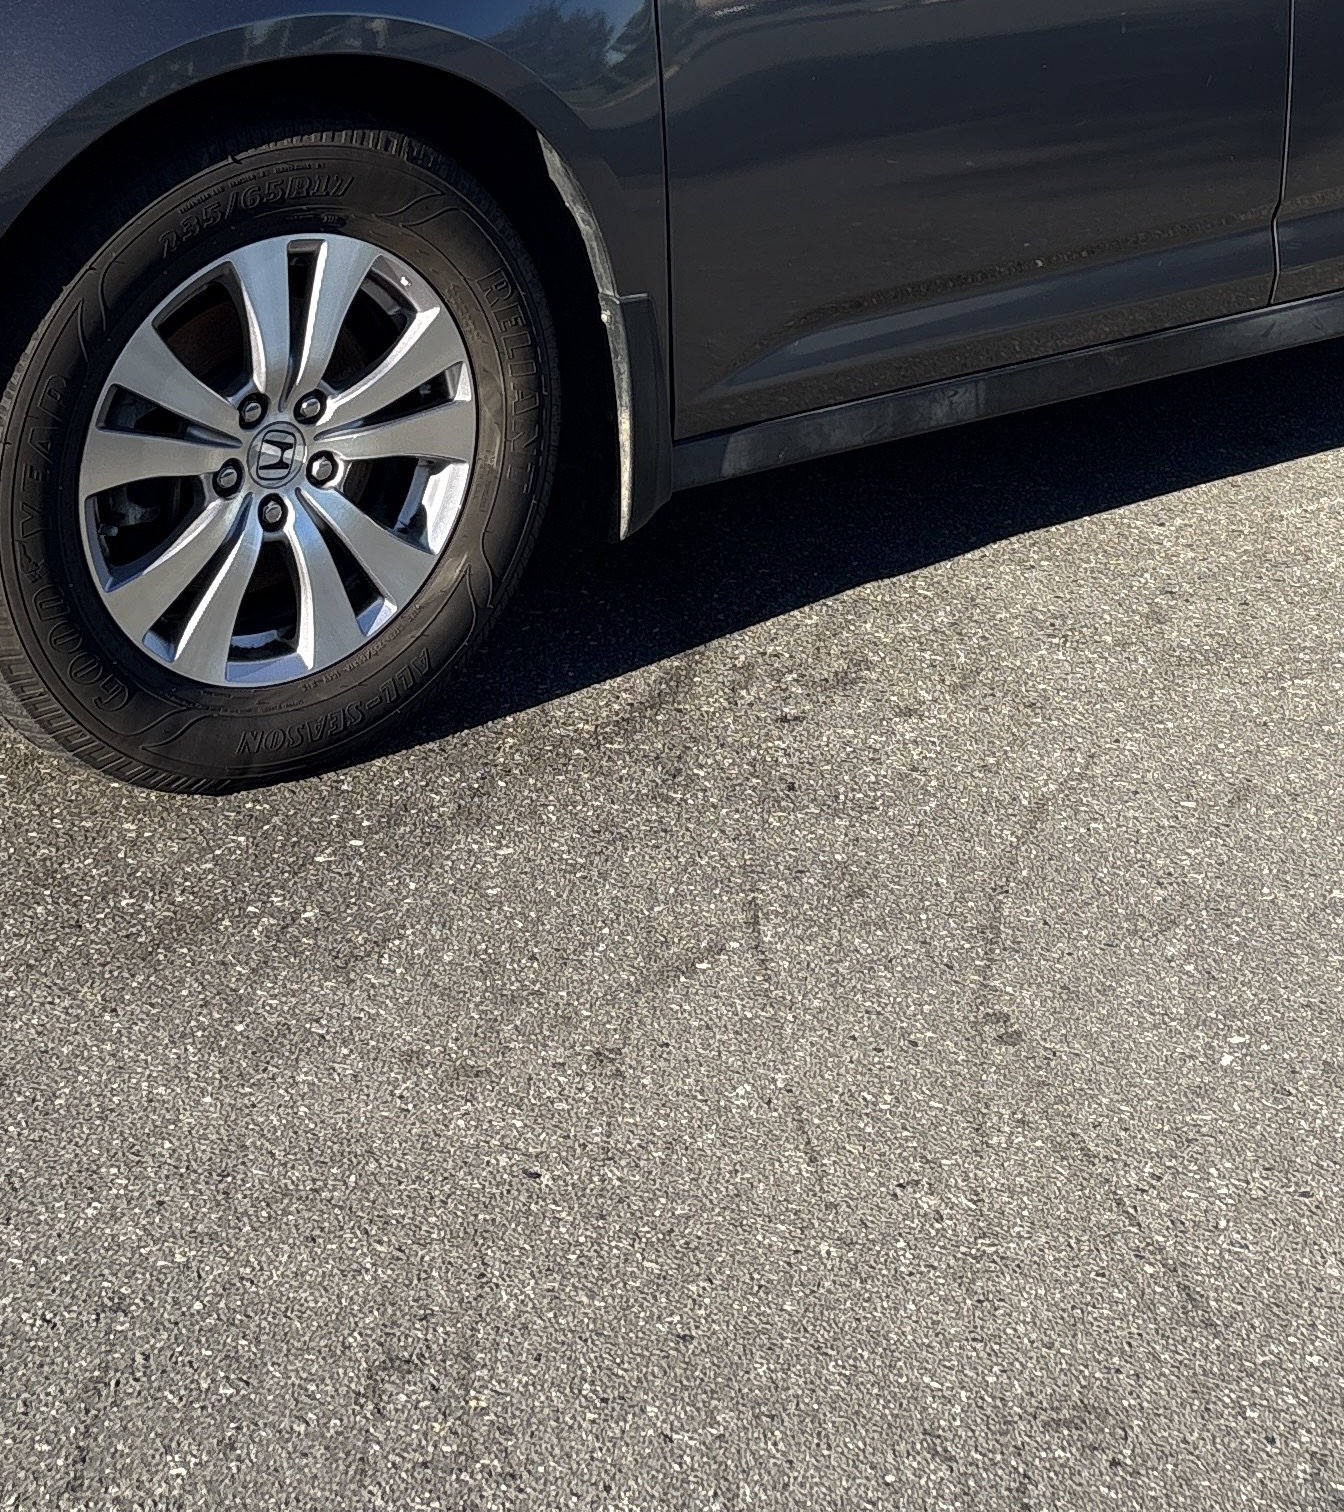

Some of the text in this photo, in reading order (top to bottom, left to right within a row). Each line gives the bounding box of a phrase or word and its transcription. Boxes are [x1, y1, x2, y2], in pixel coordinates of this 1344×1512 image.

[158, 174, 355, 259] 235/65R17
[18, 374, 129, 713] GOODYEAR
[234, 646, 432, 756] ALL-SEASON
